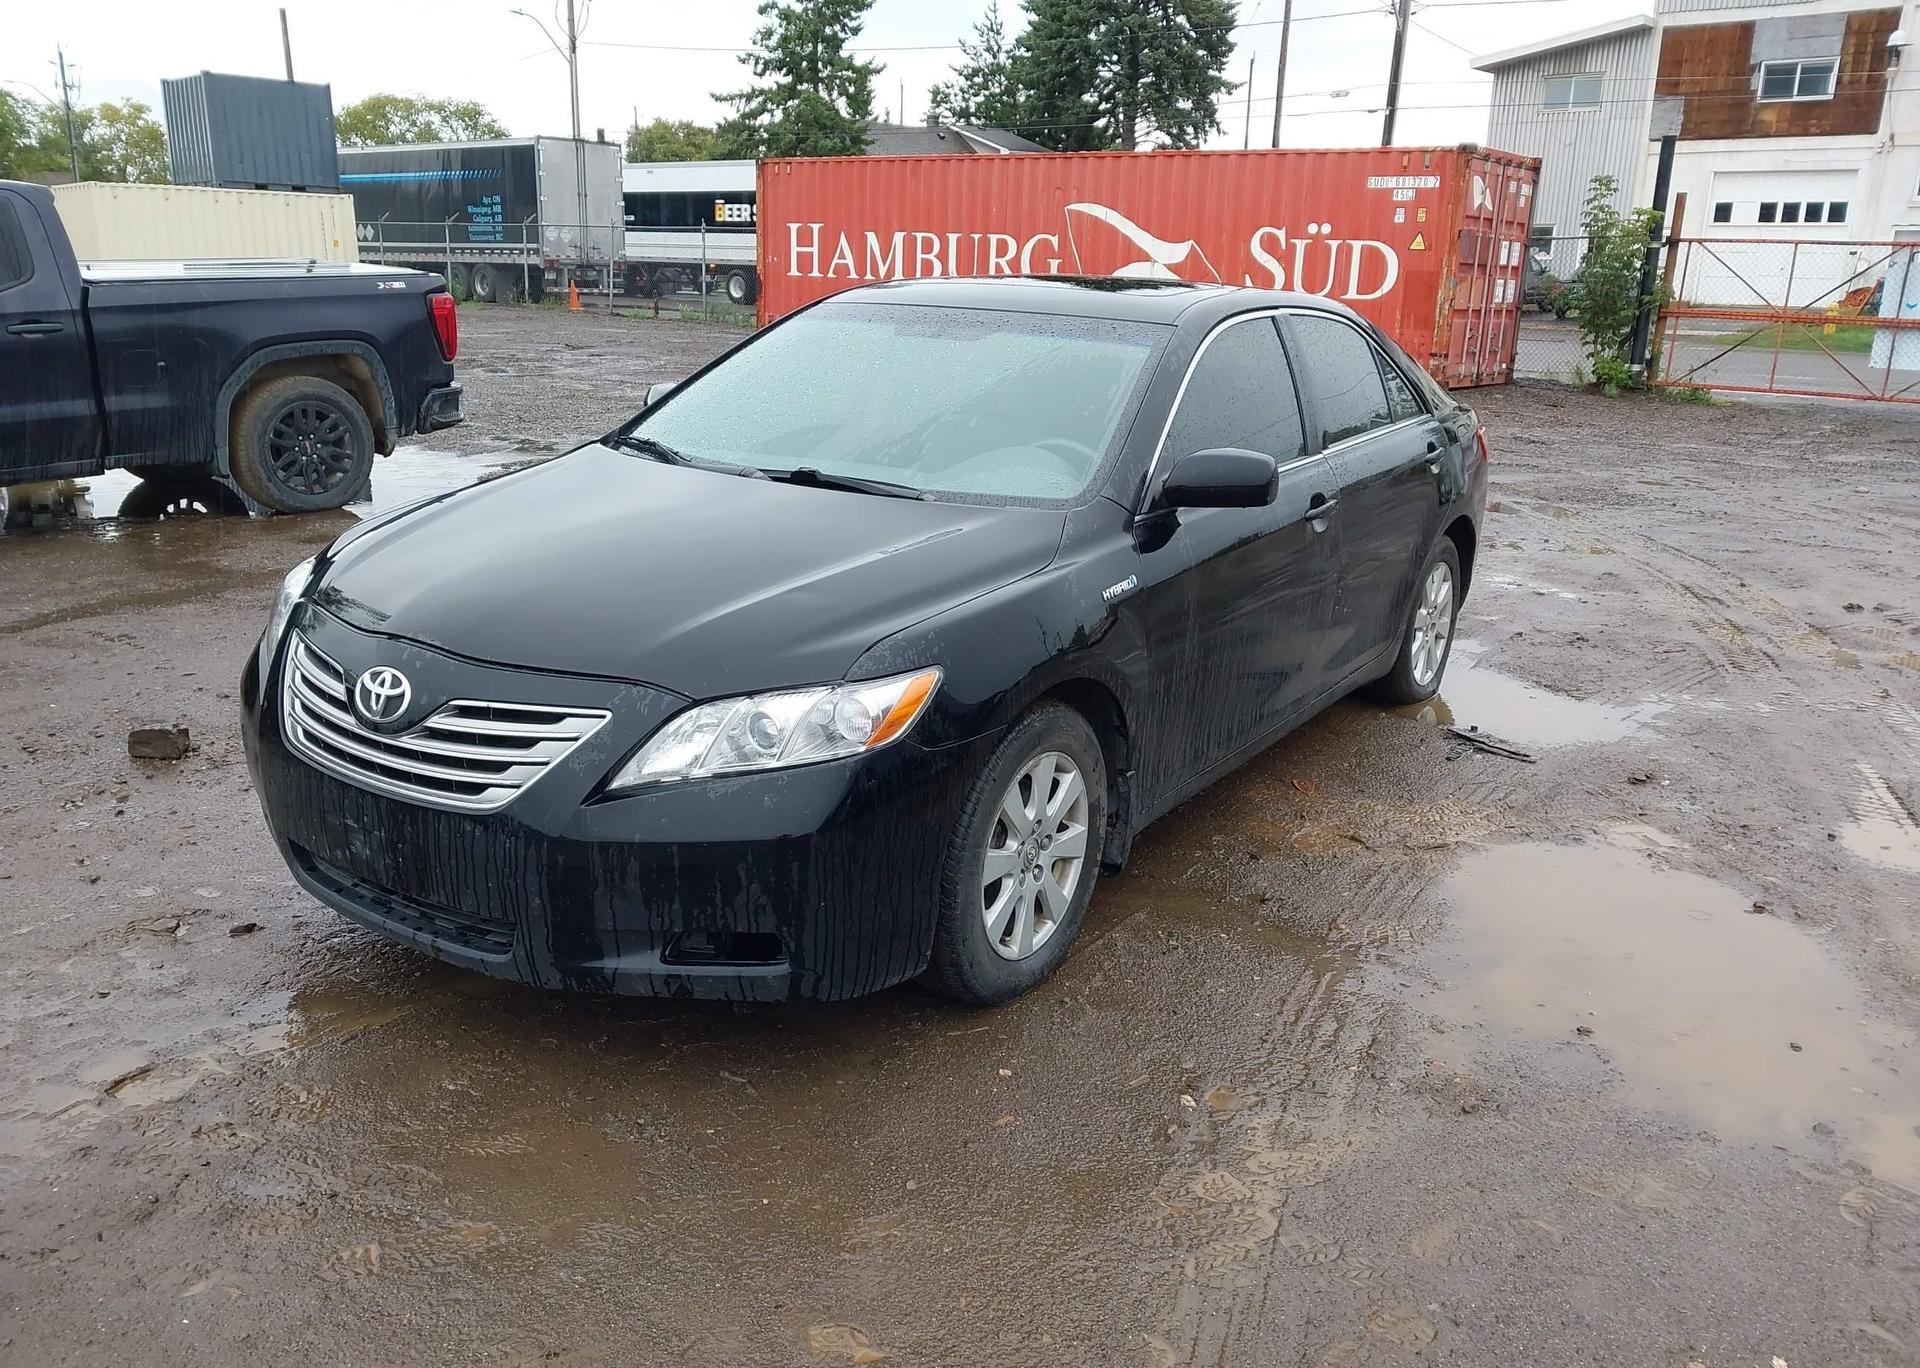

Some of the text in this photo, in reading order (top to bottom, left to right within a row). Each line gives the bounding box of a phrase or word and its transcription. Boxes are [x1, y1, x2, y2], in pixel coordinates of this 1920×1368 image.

[714, 200, 751, 222] BEER
[786, 222, 1399, 300] HAMBURG SÜD
[1102, 579, 1131, 601] HYBRID
